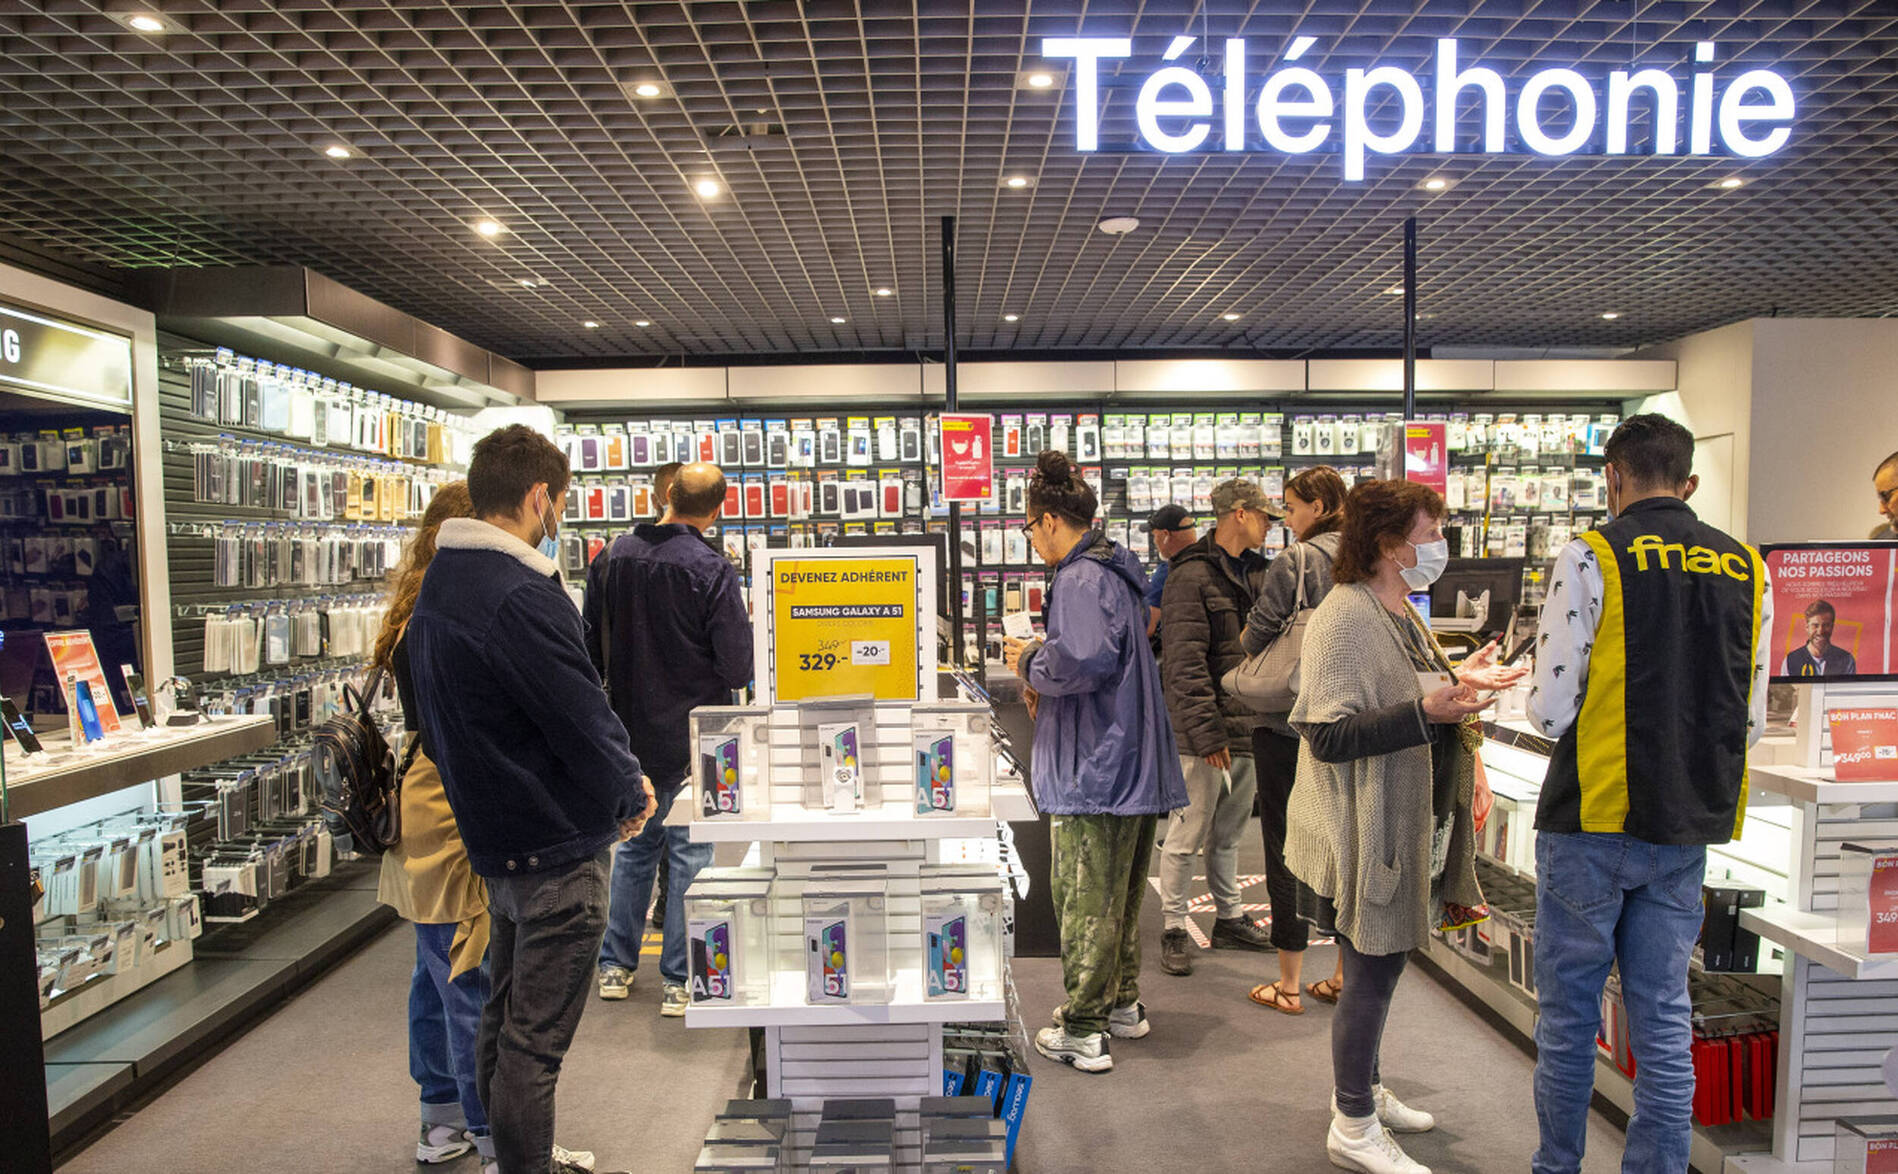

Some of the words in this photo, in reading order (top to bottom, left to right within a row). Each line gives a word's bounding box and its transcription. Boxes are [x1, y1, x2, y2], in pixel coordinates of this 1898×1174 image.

[1042, 36, 1796, 181] Téléphonie
[1627, 535, 1749, 581] fnac
[1783, 552, 1870, 564] PARTAGEONS
[780, 572, 838, 583] DEVENEZ
[840, 569, 908, 582] ADHÉRENT
[1778, 566, 1806, 578] NOS
[1809, 565, 1873, 577] PASSIONS
[792, 607, 840, 617] SAMSUNG
[842, 606, 881, 616] GALAXY
[883, 606, 890, 615] A
[892, 606, 902, 615] 51
